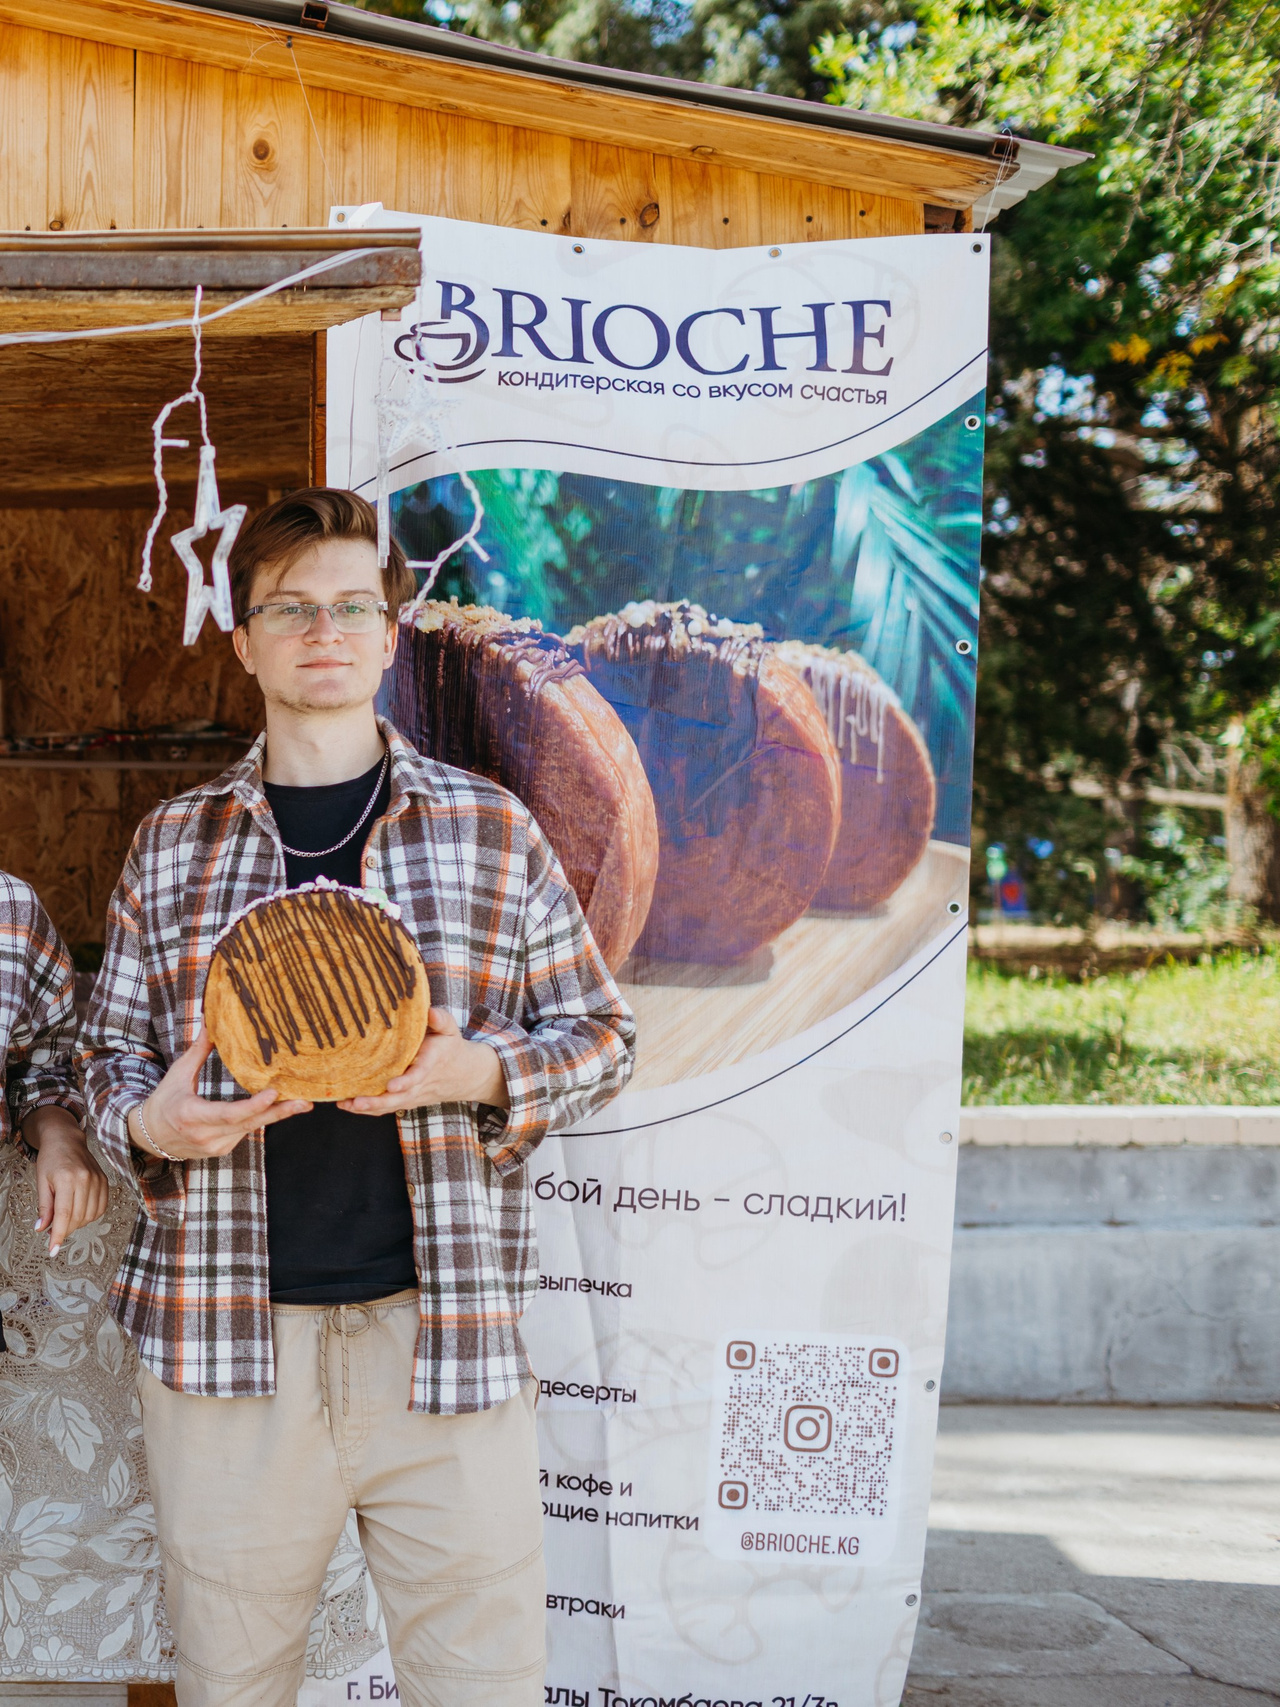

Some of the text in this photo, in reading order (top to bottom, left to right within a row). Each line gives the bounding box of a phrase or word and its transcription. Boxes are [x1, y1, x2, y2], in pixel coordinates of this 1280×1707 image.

[405, 279, 894, 379] BRIOCHE
[497, 368, 888, 405] кондитерская со вкусом счастья
[531, 1171, 602, 1206] бой
[612, 1186, 701, 1214] день
[743, 1190, 907, 1224] сладкий!
[540, 1379, 637, 1405] десерты
[556, 1473, 614, 1498] кофе
[619, 1482, 633, 1497] и
[605, 1511, 699, 1531] напитки
[740, 1531, 860, 1556] @BRIOCHE.KG
[347, 1681, 361, 1701] г.
